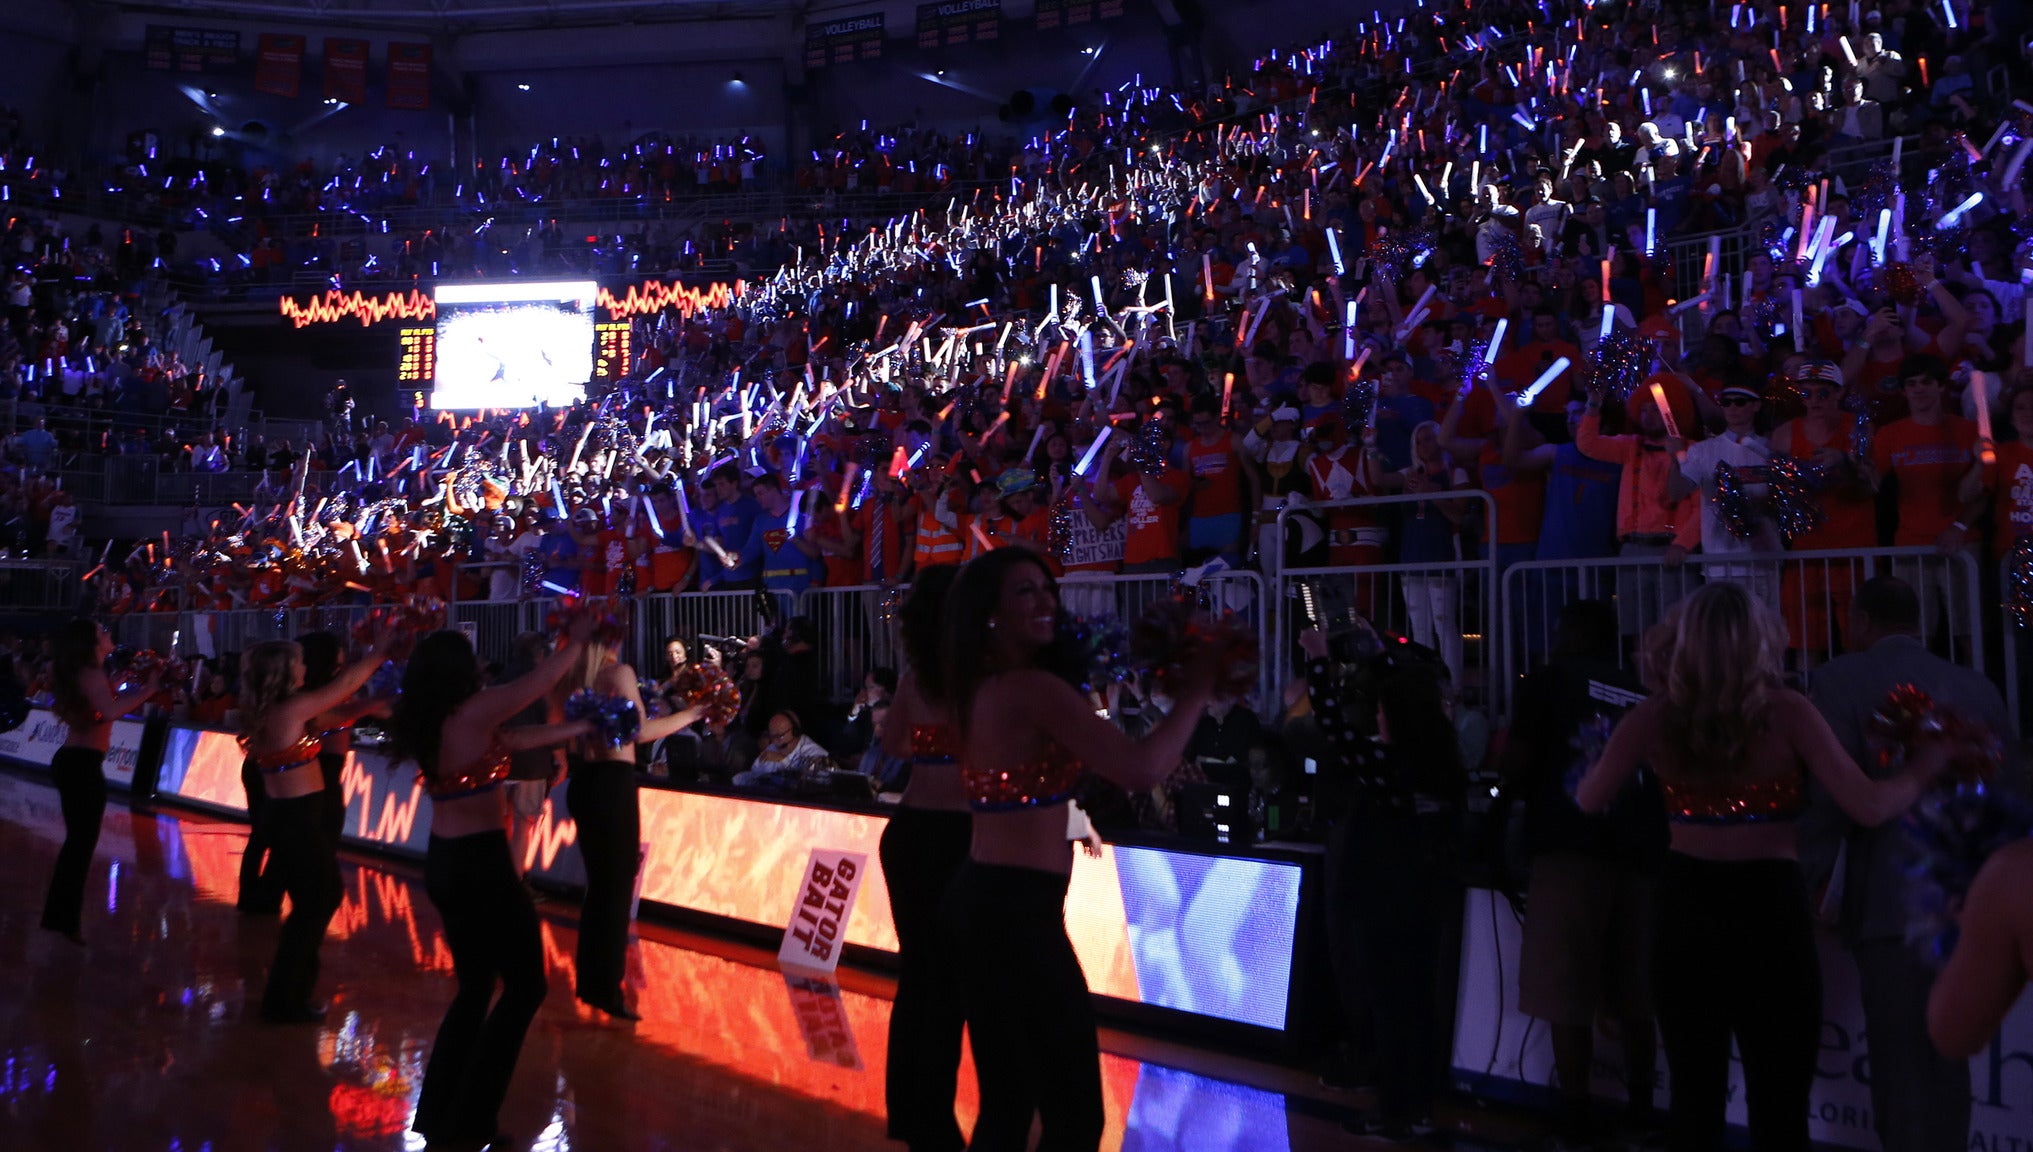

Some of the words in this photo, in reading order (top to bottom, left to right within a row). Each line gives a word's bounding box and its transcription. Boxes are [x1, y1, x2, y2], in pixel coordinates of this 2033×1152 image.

[824, 17, 882, 36] VOLLEYBALL
[938, 0, 999, 17] VOLLEYBALL
[792, 859, 835, 952] BAIT
[810, 857, 857, 963] GATOR
